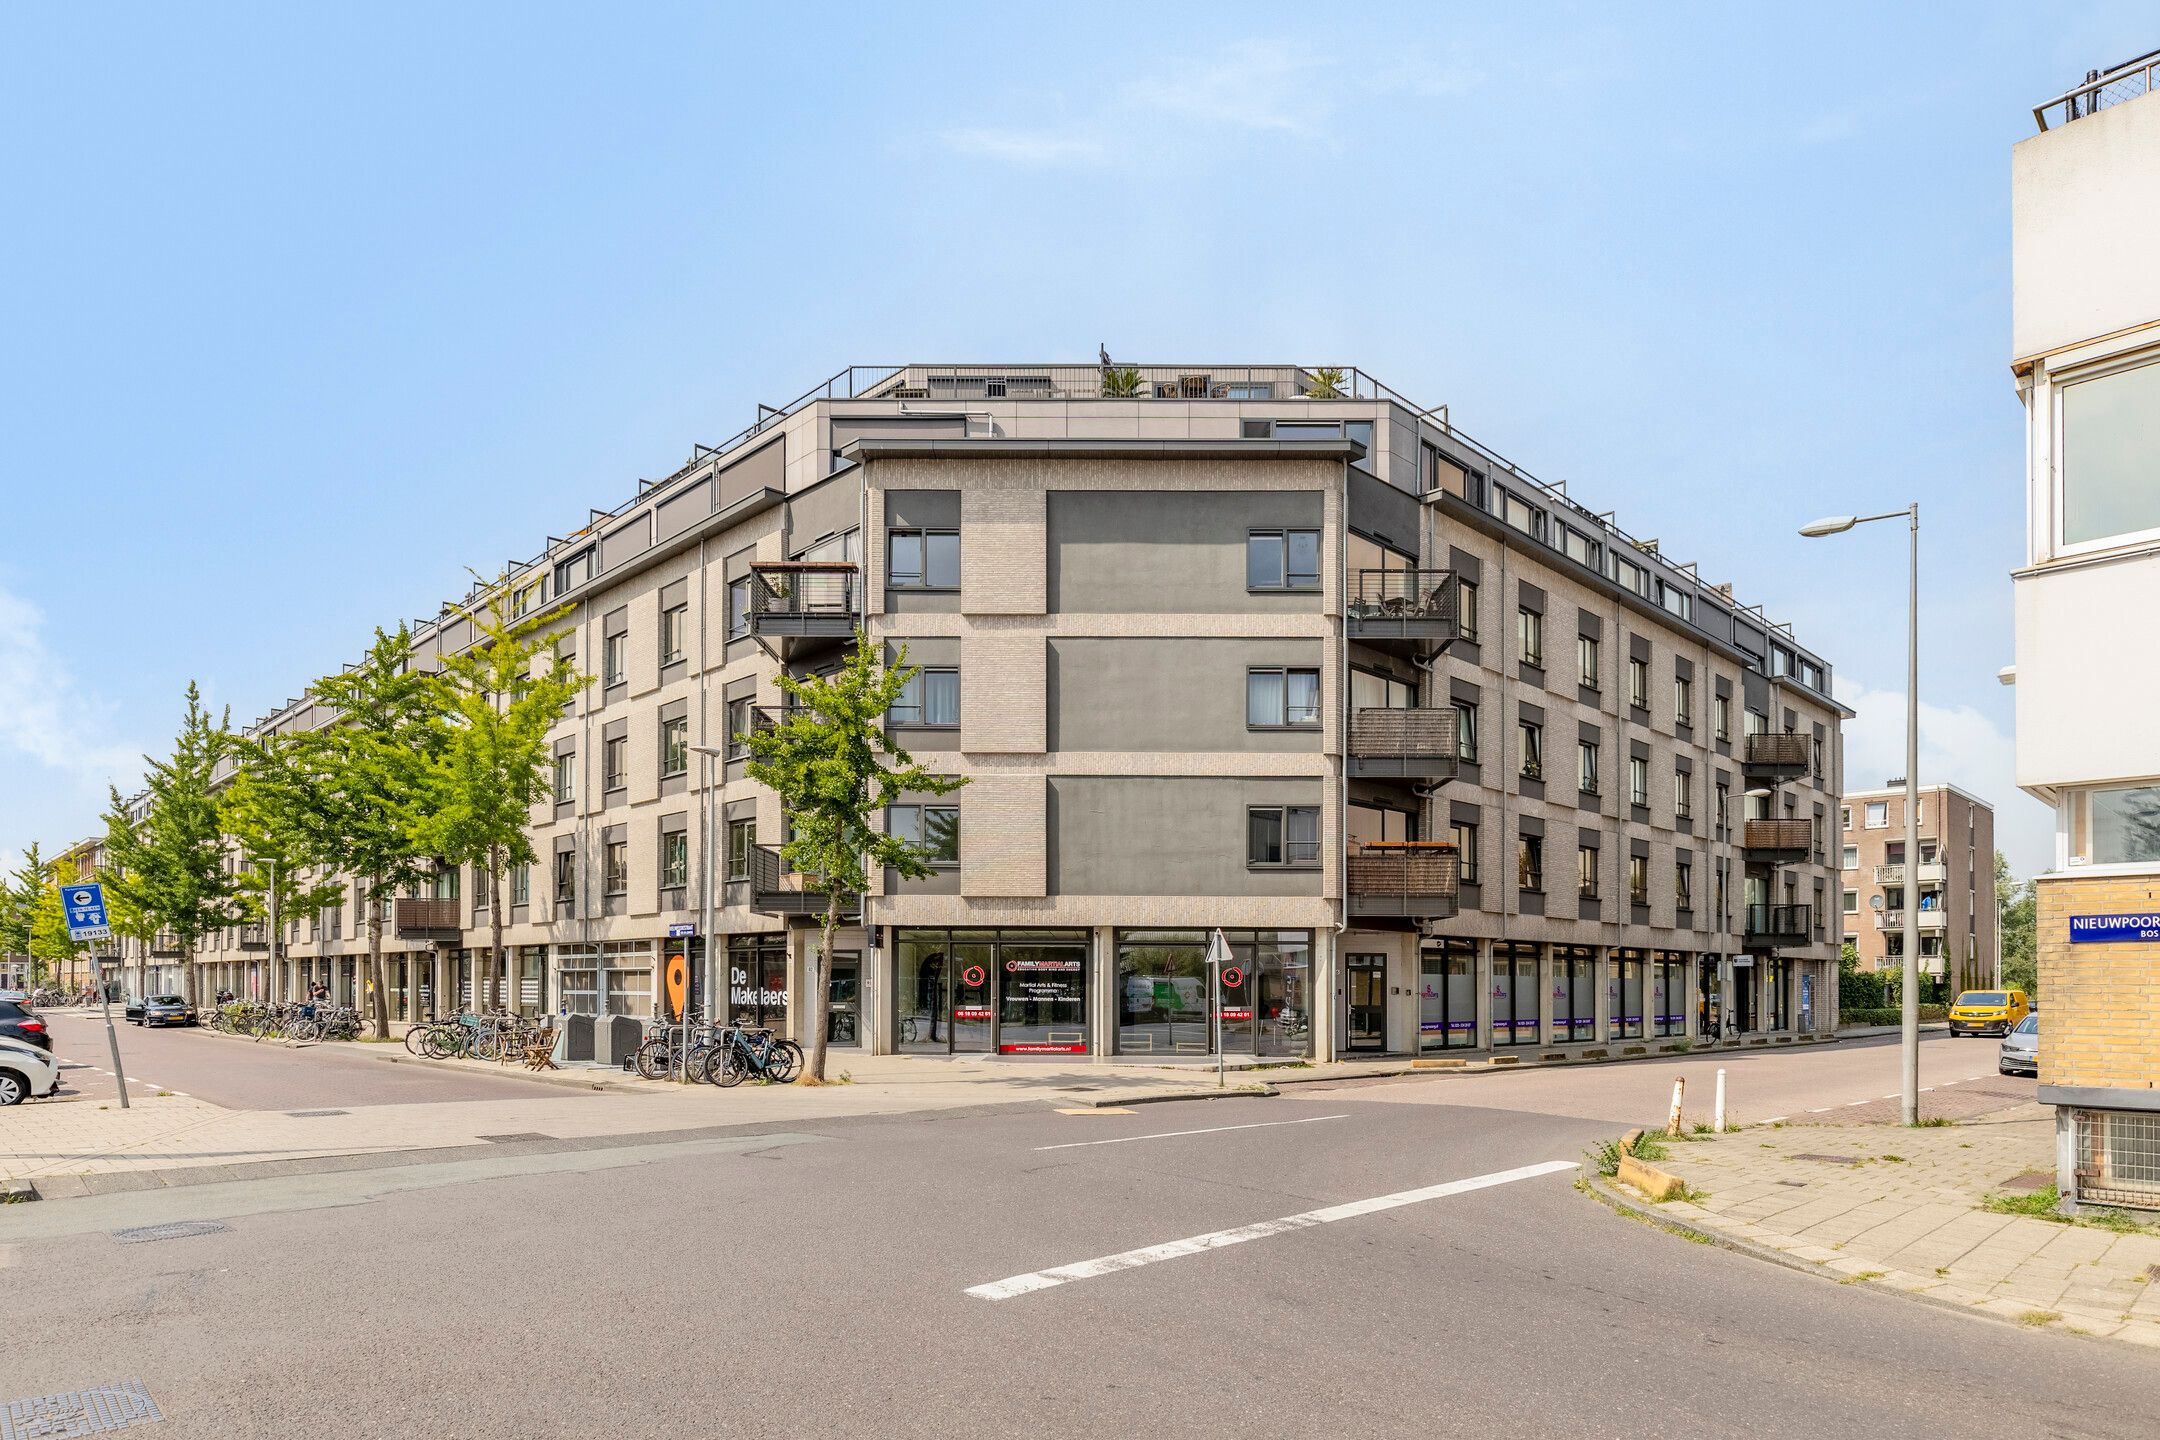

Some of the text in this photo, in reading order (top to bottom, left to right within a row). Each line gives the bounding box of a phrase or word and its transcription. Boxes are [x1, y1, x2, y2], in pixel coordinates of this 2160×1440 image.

[83, 929, 108, 937] 19133
[2140, 930, 2159, 938] BOS
[731, 966, 747, 985] De
[731, 986, 788, 1005] Makelaers
